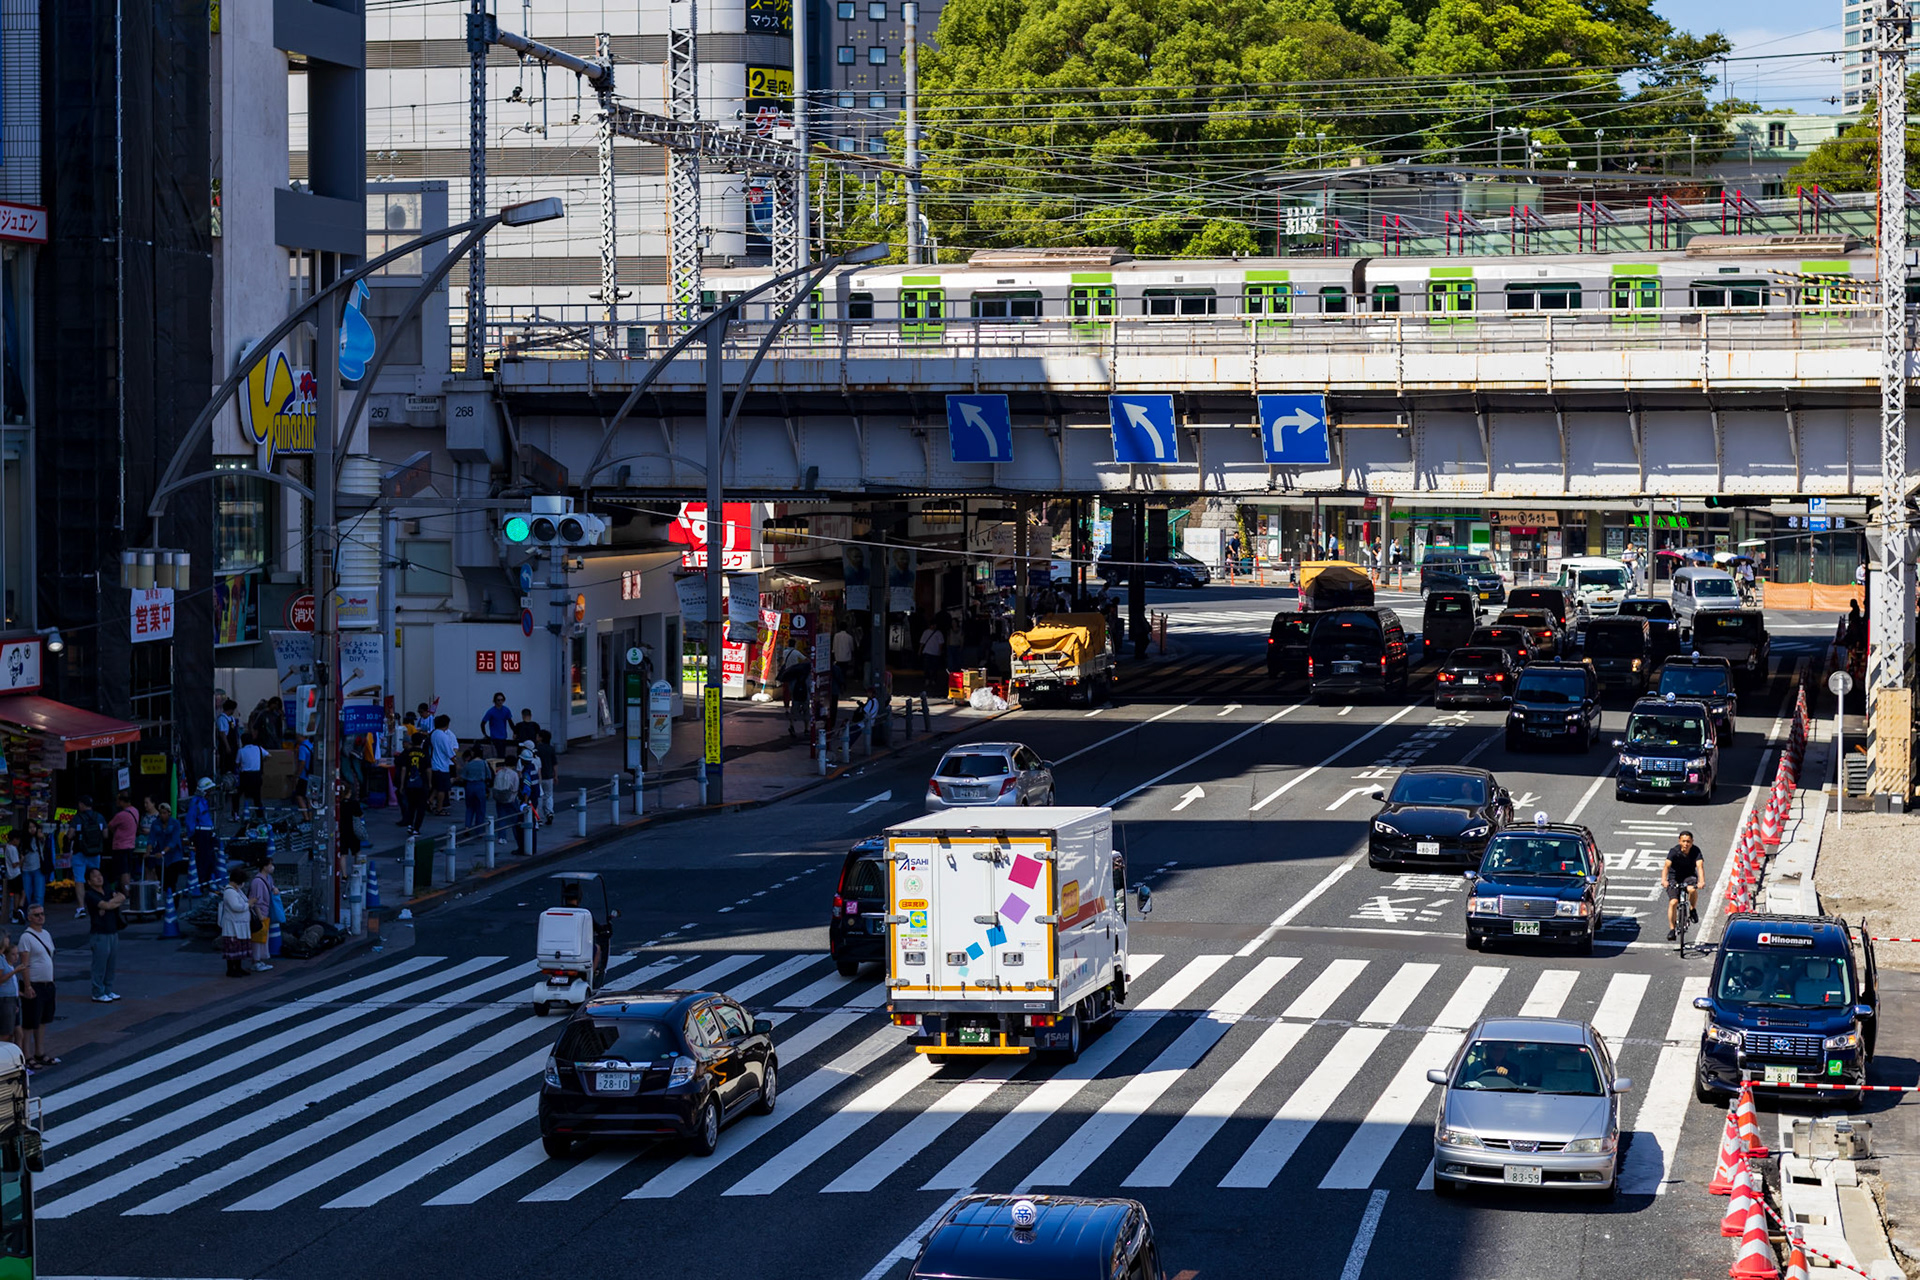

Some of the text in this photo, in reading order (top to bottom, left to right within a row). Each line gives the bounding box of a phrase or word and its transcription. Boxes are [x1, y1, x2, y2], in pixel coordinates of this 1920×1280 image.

[750, 0, 793, 12] スーツケ
[751, 15, 779, 27] マウス
[0, 209, 38, 234] ジュエン
[1286, 216, 1318, 235] 3153
[371, 407, 389, 419] 267
[455, 406, 474, 418] 268
[1812, 497, 1822, 511] P
[136, 602, 171, 634] 営業中
[294, 607, 315, 623] 消火
[479, 653, 494, 661] ユニ
[503, 653, 518, 662] UNI
[479, 662, 494, 670] クロ
[503, 662, 519, 671] QLO
[899, 858, 929, 871] ASAHI
[1771, 935, 1813, 945] Hinomaru
[603, 1079, 628, 1089] 28-10
[1512, 1172, 1540, 1183] 83-59
